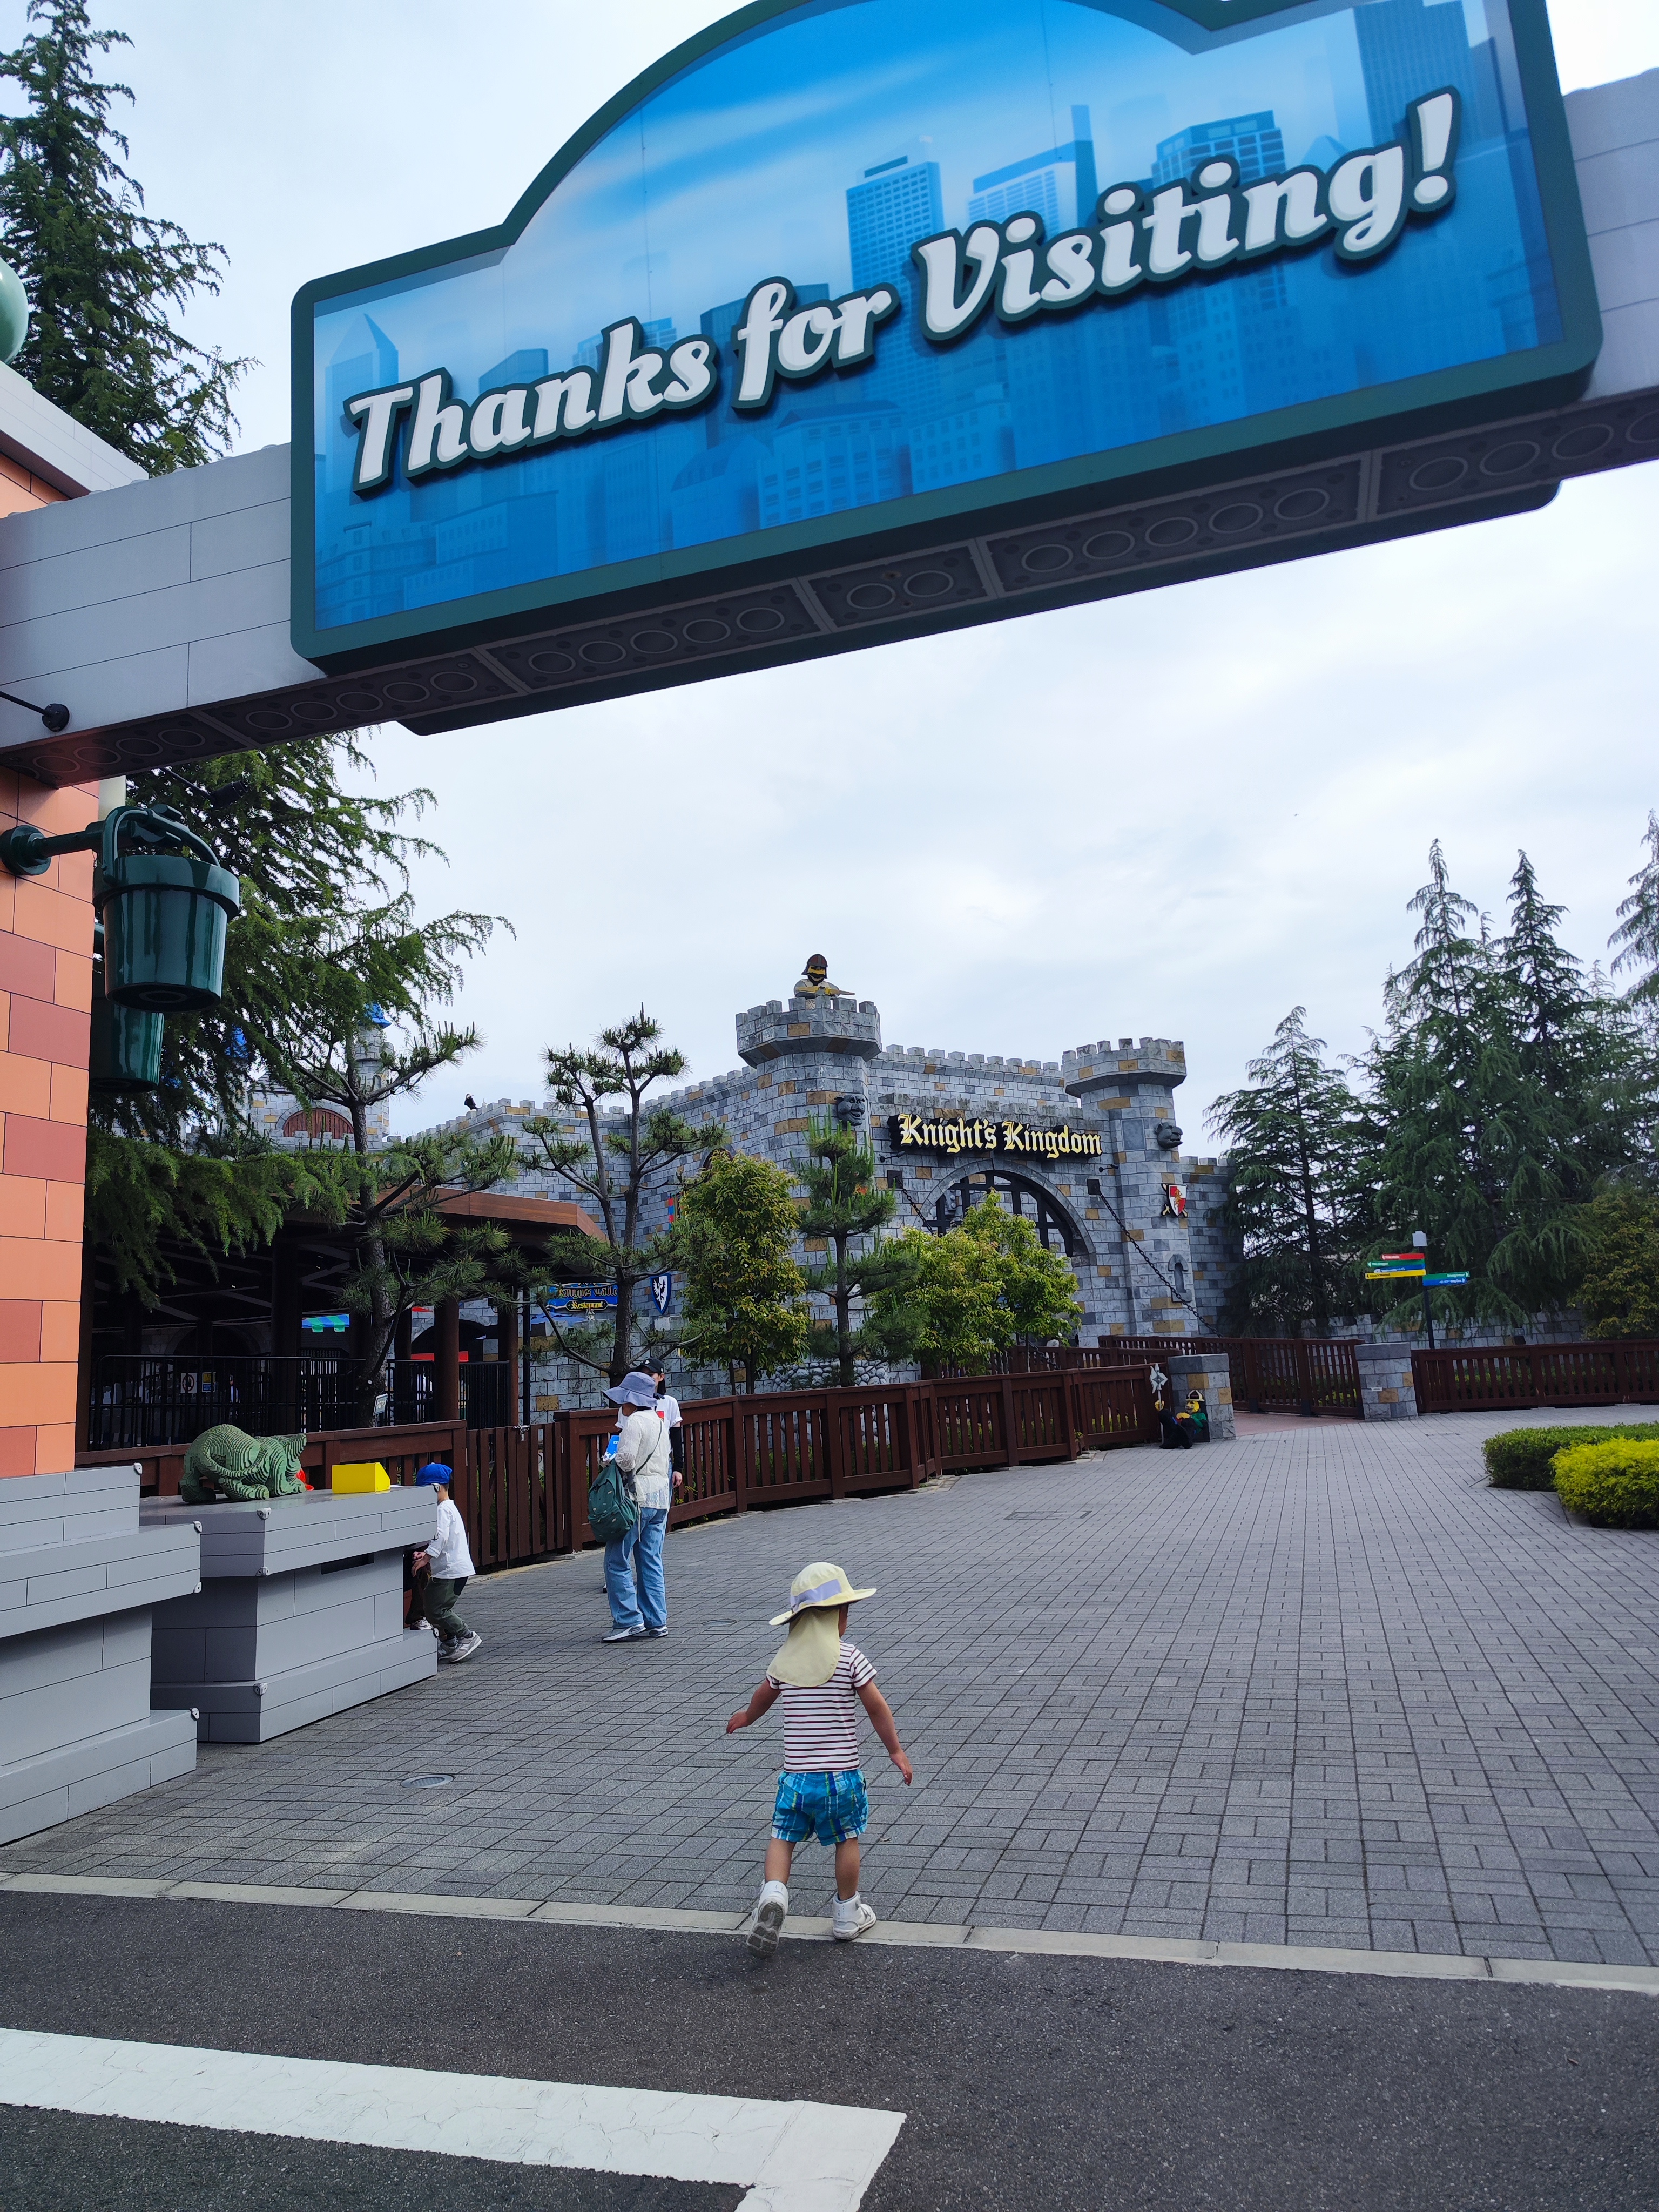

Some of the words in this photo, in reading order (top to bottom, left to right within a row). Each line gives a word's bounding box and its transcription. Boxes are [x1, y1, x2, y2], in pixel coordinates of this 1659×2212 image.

[349, 323, 712, 484] Thanks
[737, 281, 892, 402] for
[916, 93, 1454, 334] Visiting!
[898, 1113, 997, 1154] Knight's
[1001, 1120, 1103, 1158] Kingdom
